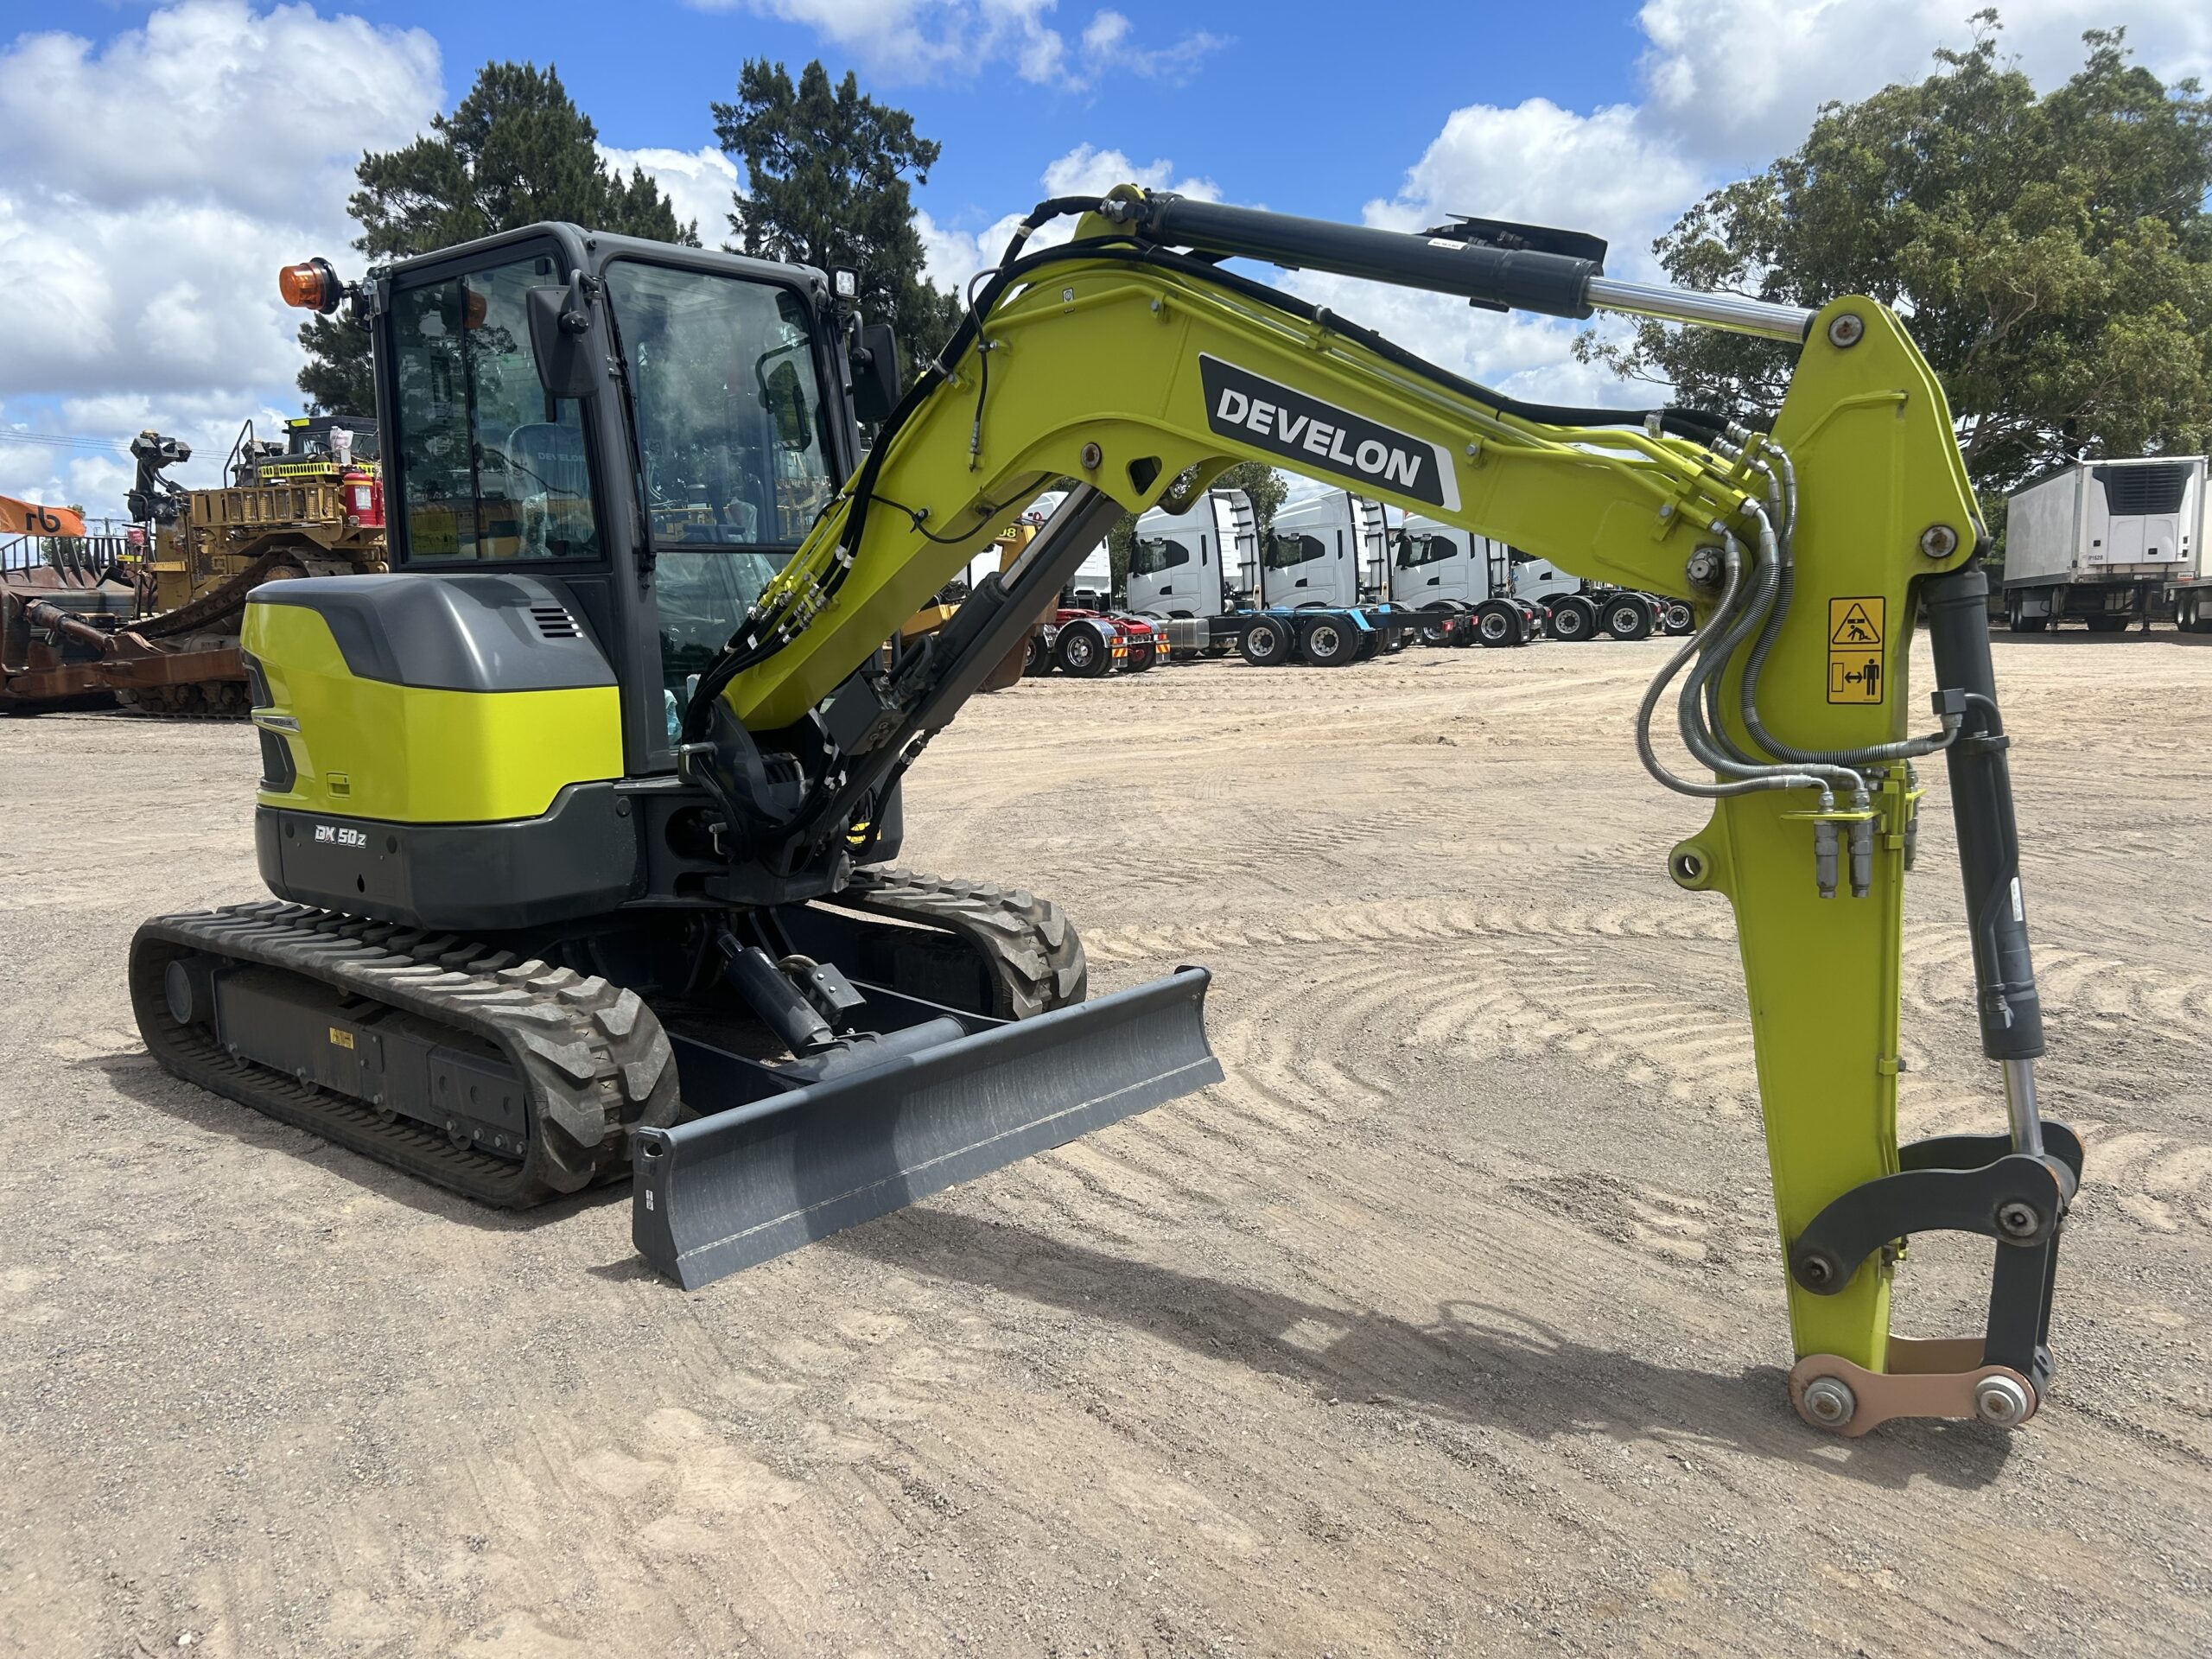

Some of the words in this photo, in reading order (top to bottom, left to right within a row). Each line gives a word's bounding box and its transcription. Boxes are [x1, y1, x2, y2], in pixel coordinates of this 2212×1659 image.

[1217, 388, 1422, 488] DEVELON
[26, 505, 61, 533] rb
[315, 824, 336, 844] DX
